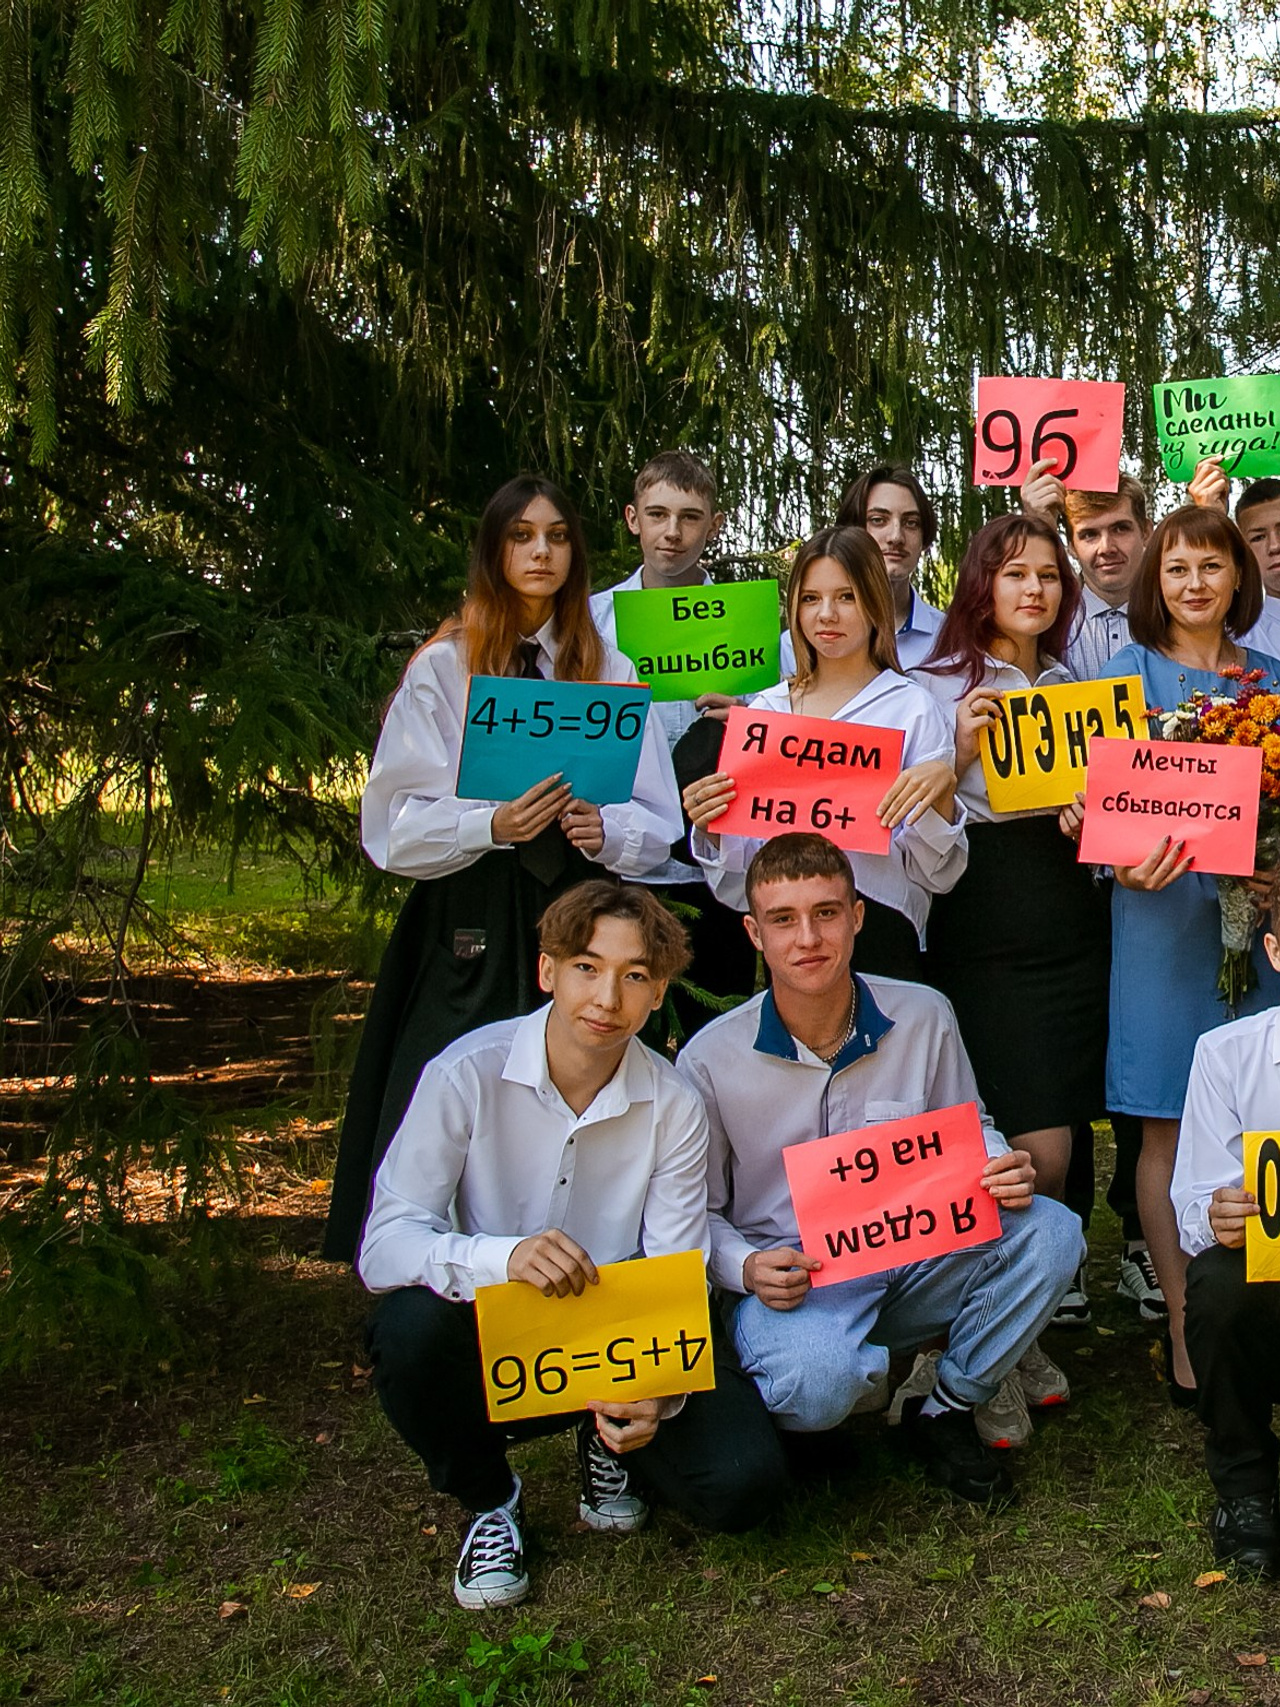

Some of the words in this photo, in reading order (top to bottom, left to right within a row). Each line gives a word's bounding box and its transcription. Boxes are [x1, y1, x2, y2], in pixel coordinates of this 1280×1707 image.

[1163, 387, 1228, 419] Мы
[1165, 410, 1276, 437] сделаны
[1163, 441, 1185, 468] из
[1198, 431, 1280, 474] чуда!
[672, 596, 726, 622] Без
[638, 643, 766, 676] ашыбак
[742, 723, 767, 753] Я
[780, 735, 880, 769] сдам
[987, 693, 1055, 779] ОГЭ
[1113, 683, 1135, 739] 5
[1132, 749, 1216, 774] Мечты
[750, 797, 796, 824] на
[810, 798, 855, 829] 6+
[1102, 791, 1241, 820] сбываются
[830, 1148, 879, 1183] 6+
[891, 1131, 942, 1166] на
[826, 1203, 938, 1259] сдам
[950, 1198, 976, 1234] Я
